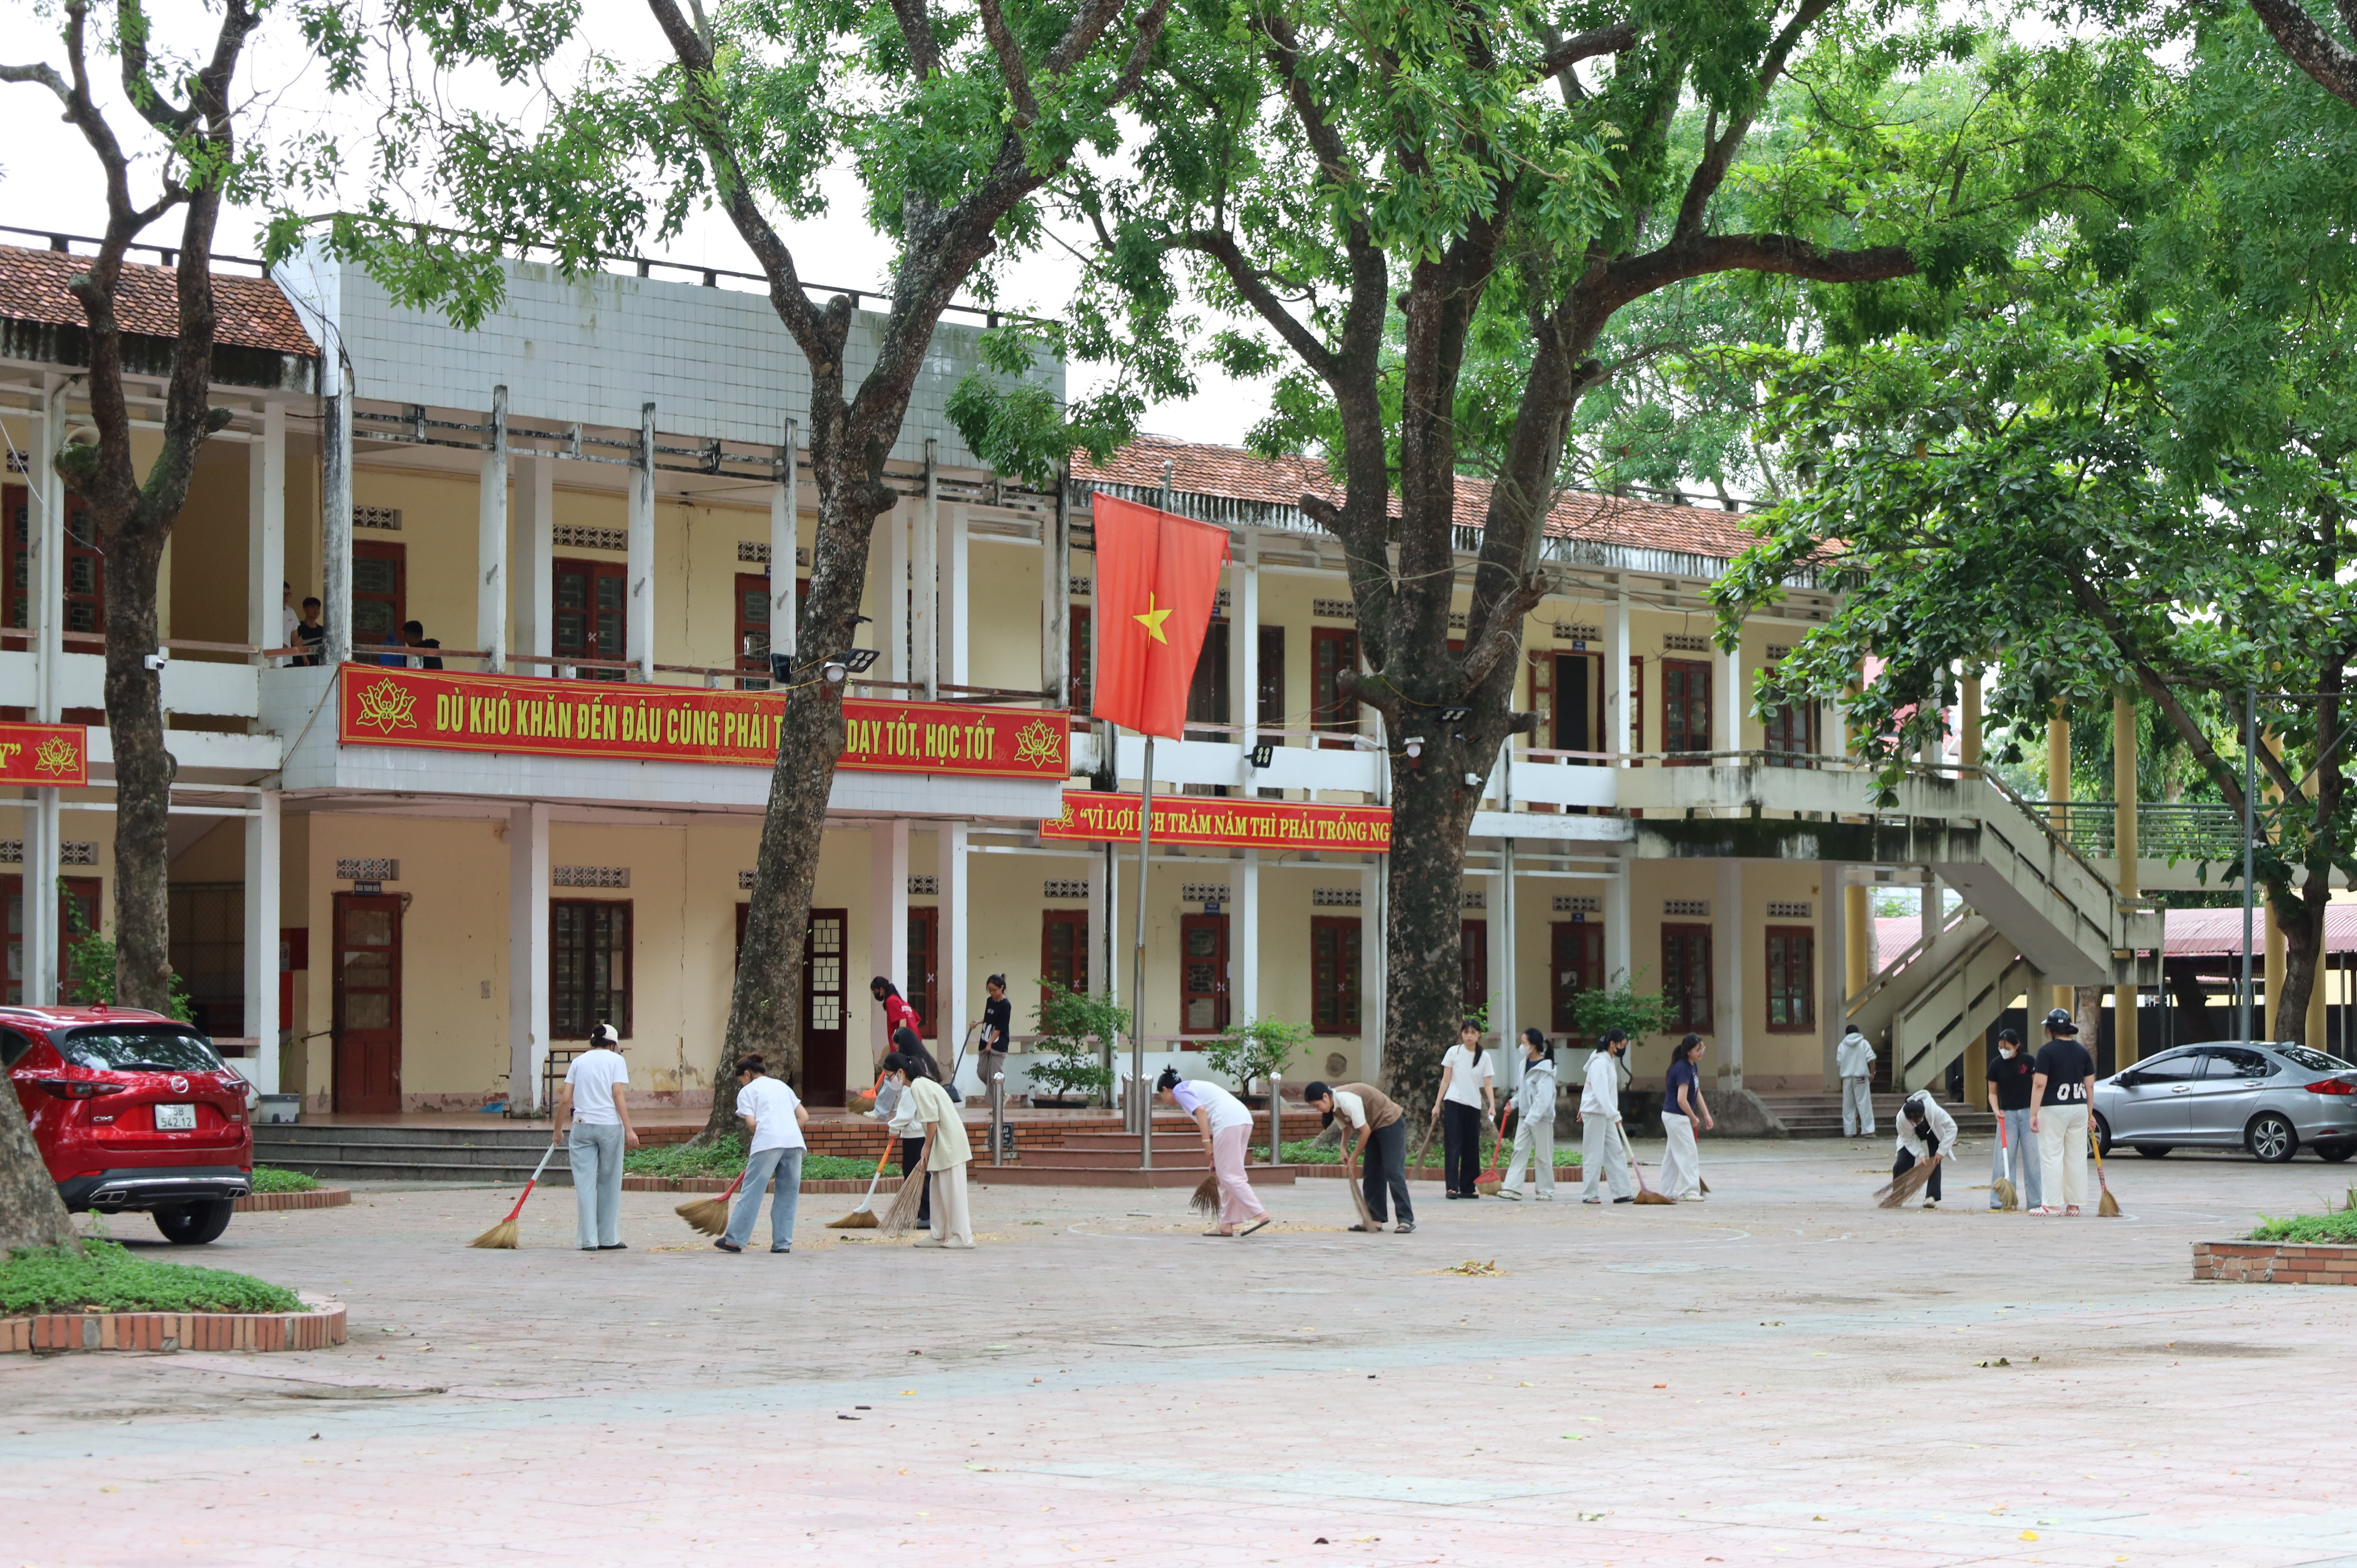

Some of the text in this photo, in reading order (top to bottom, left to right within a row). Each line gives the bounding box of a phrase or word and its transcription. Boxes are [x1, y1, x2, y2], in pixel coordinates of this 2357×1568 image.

[437, 687, 463, 732] DÙ
[470, 691, 510, 735] KHÓ
[516, 694, 572, 739] KHĂN
[577, 692, 616, 740] ĐẾN
[622, 699, 661, 743] ĐÂU
[667, 702, 718, 746] CŨNG
[724, 701, 768, 748] PHẢI
[846, 719, 882, 761] DẠY
[886, 710, 920, 761] TỐT,
[925, 723, 960, 765] HỌC
[964, 715, 995, 760] TỐT
[1079, 803, 1104, 830] “VÌ
[1106, 807, 1135, 836] LỢI
[1168, 808, 1212, 835] TRĂM
[1214, 810, 1248, 837] NĂM
[1249, 812, 1277, 838] THÌ
[1279, 811, 1315, 840] PHẢI
[1317, 811, 1367, 841] TRỒNG
[1368, 822, 1392, 842] NG
[161, 1117, 192, 1127] 542.12
